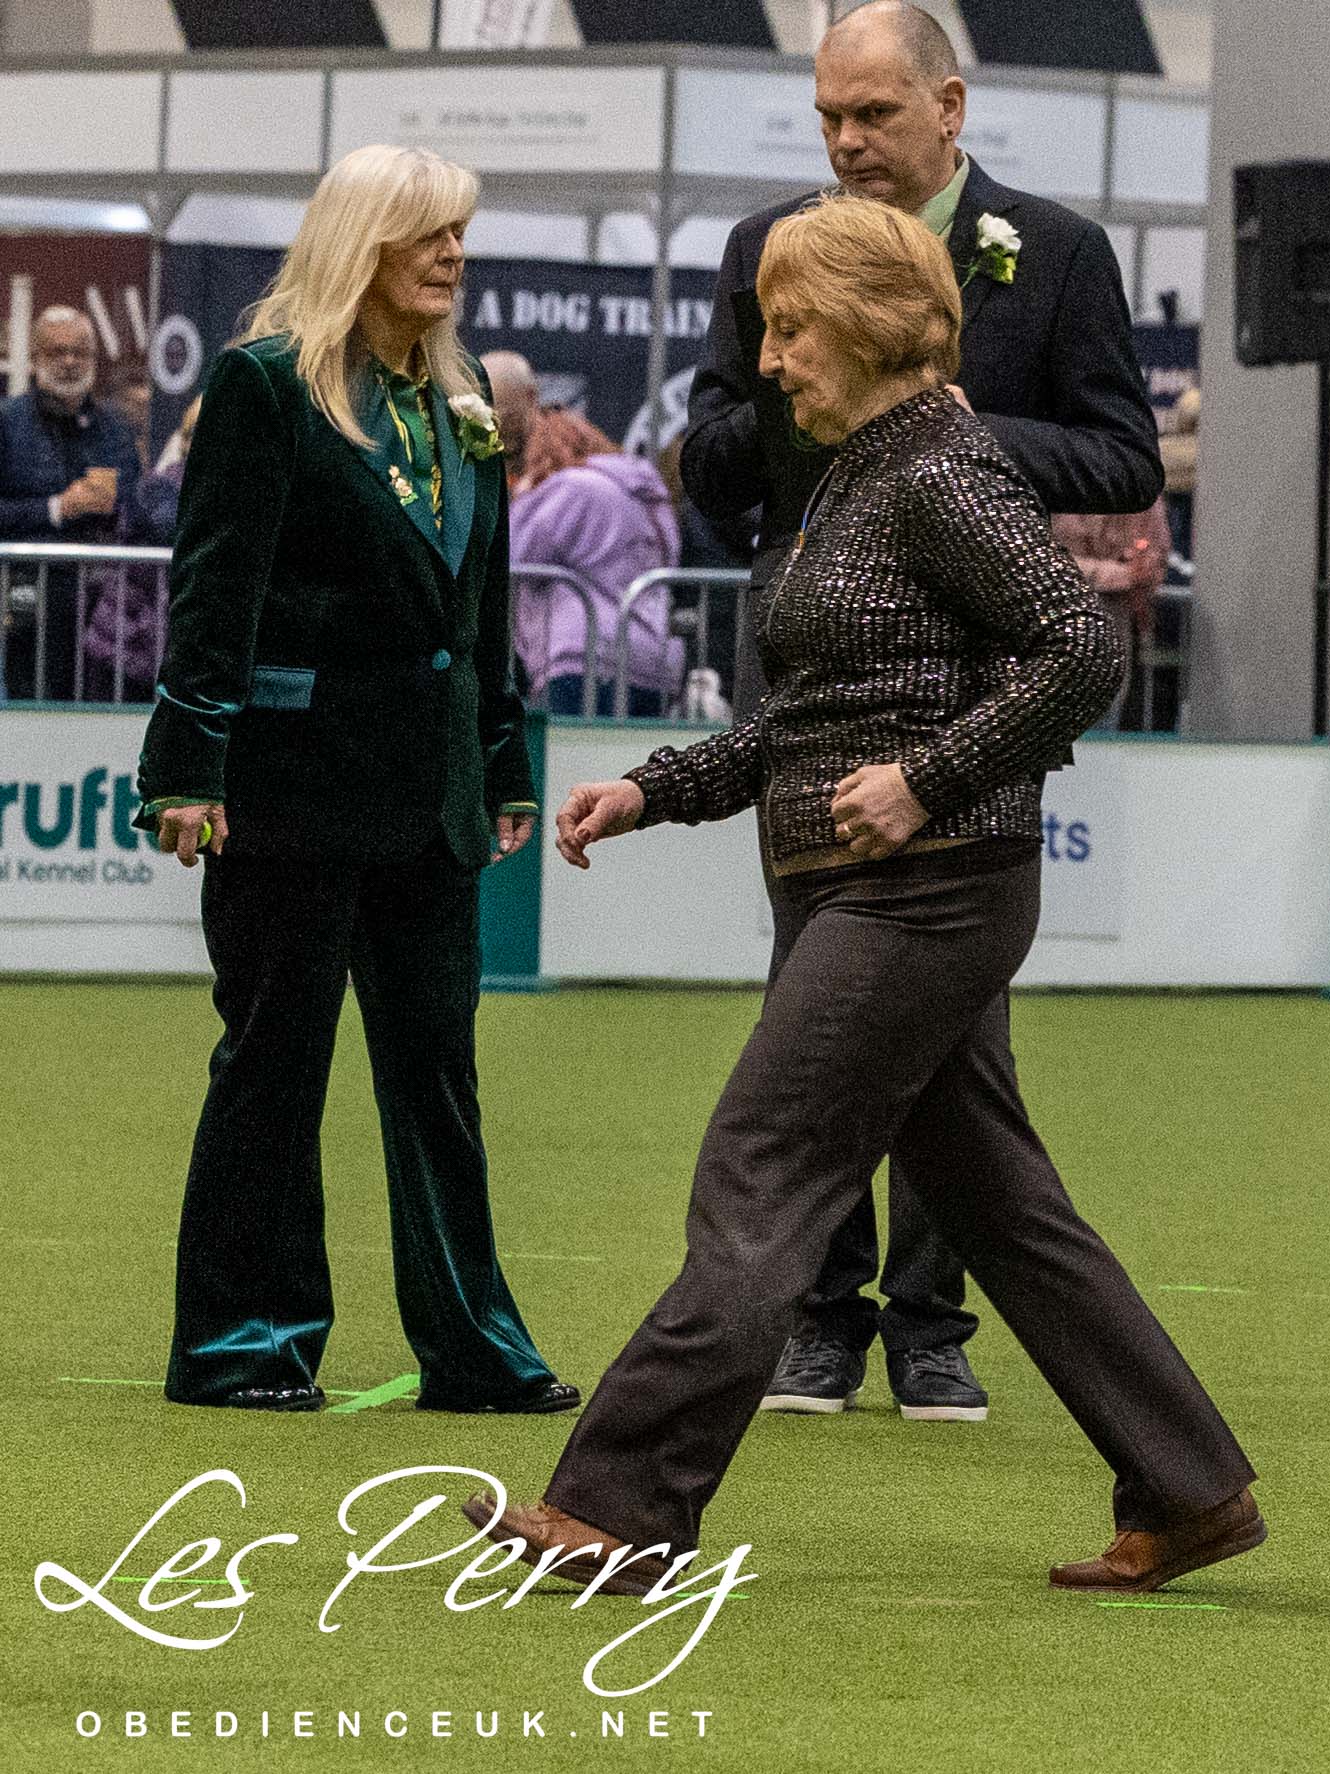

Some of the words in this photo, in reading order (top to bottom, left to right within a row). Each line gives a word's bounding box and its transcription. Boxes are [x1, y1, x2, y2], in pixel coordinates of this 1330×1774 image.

[475, 289, 500, 329] A
[512, 290, 590, 332] DOG
[0, 766, 161, 851] ruft
[102, 859, 153, 885] Club
